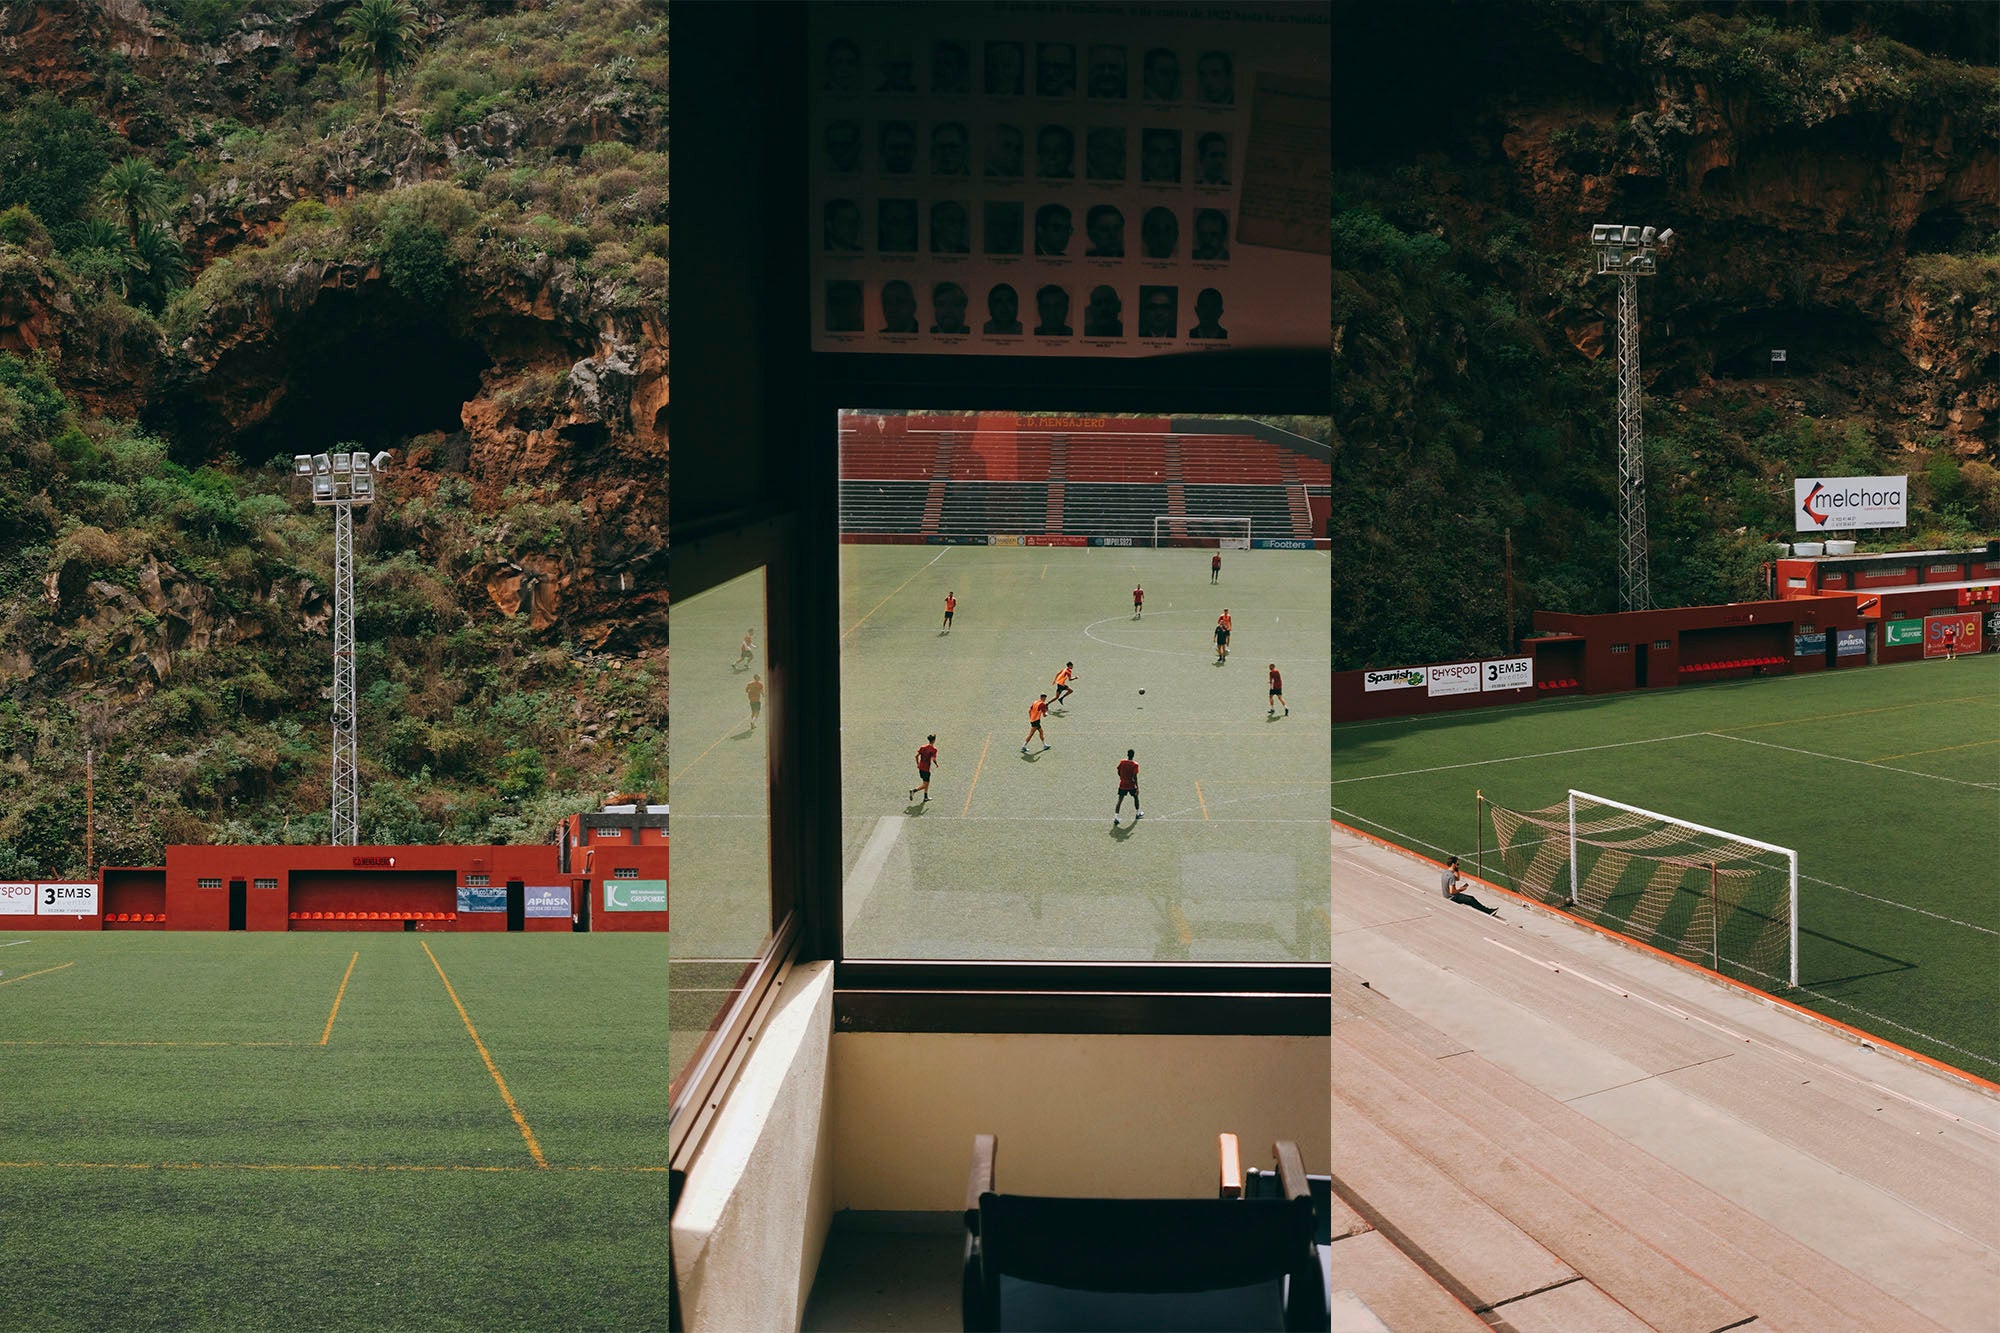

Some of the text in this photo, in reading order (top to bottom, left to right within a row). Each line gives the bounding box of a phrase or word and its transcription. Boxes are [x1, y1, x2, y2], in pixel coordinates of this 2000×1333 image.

[1816, 488, 1901, 508] melchora
[1270, 540, 1306, 549] Footters
[1367, 669, 1412, 685] Spanish
[1432, 666, 1478, 680] PHYSPOD
[0, 886, 31, 899] SPOD
[527, 897, 569, 906] APINSA
